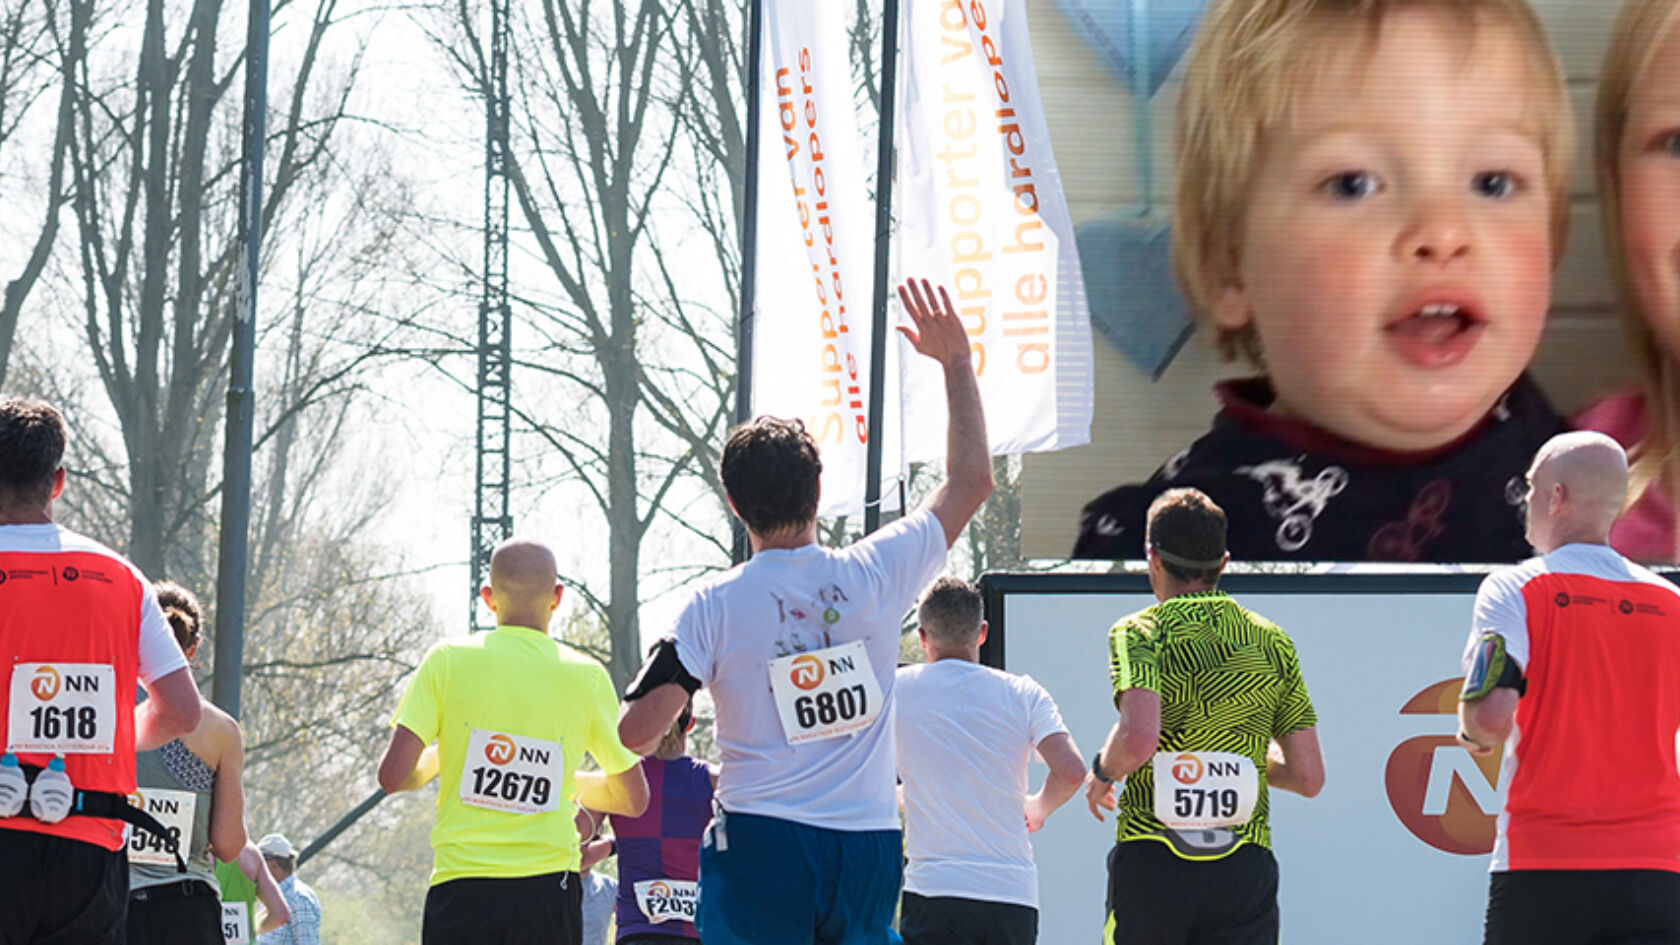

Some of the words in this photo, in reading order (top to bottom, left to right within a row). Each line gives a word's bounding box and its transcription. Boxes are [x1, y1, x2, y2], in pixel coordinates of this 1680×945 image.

[776, 67, 799, 162] van
[798, 47, 849, 333] hardlopers
[1002, 273, 1050, 375] alle
[846, 352, 868, 444] alle
[828, 656, 855, 676] NN
[65, 675, 99, 692] NN
[795, 684, 867, 729] 6807
[30, 706, 97, 739] 1618
[519, 747, 550, 765] NN
[1208, 762, 1240, 777] NN
[473, 767, 551, 806] 12679
[148, 799, 179, 815] NN
[1174, 789, 1238, 818] 5719
[672, 888, 696, 897] NN
[225, 908, 239, 916] NN
[645, 897, 696, 917] F203
